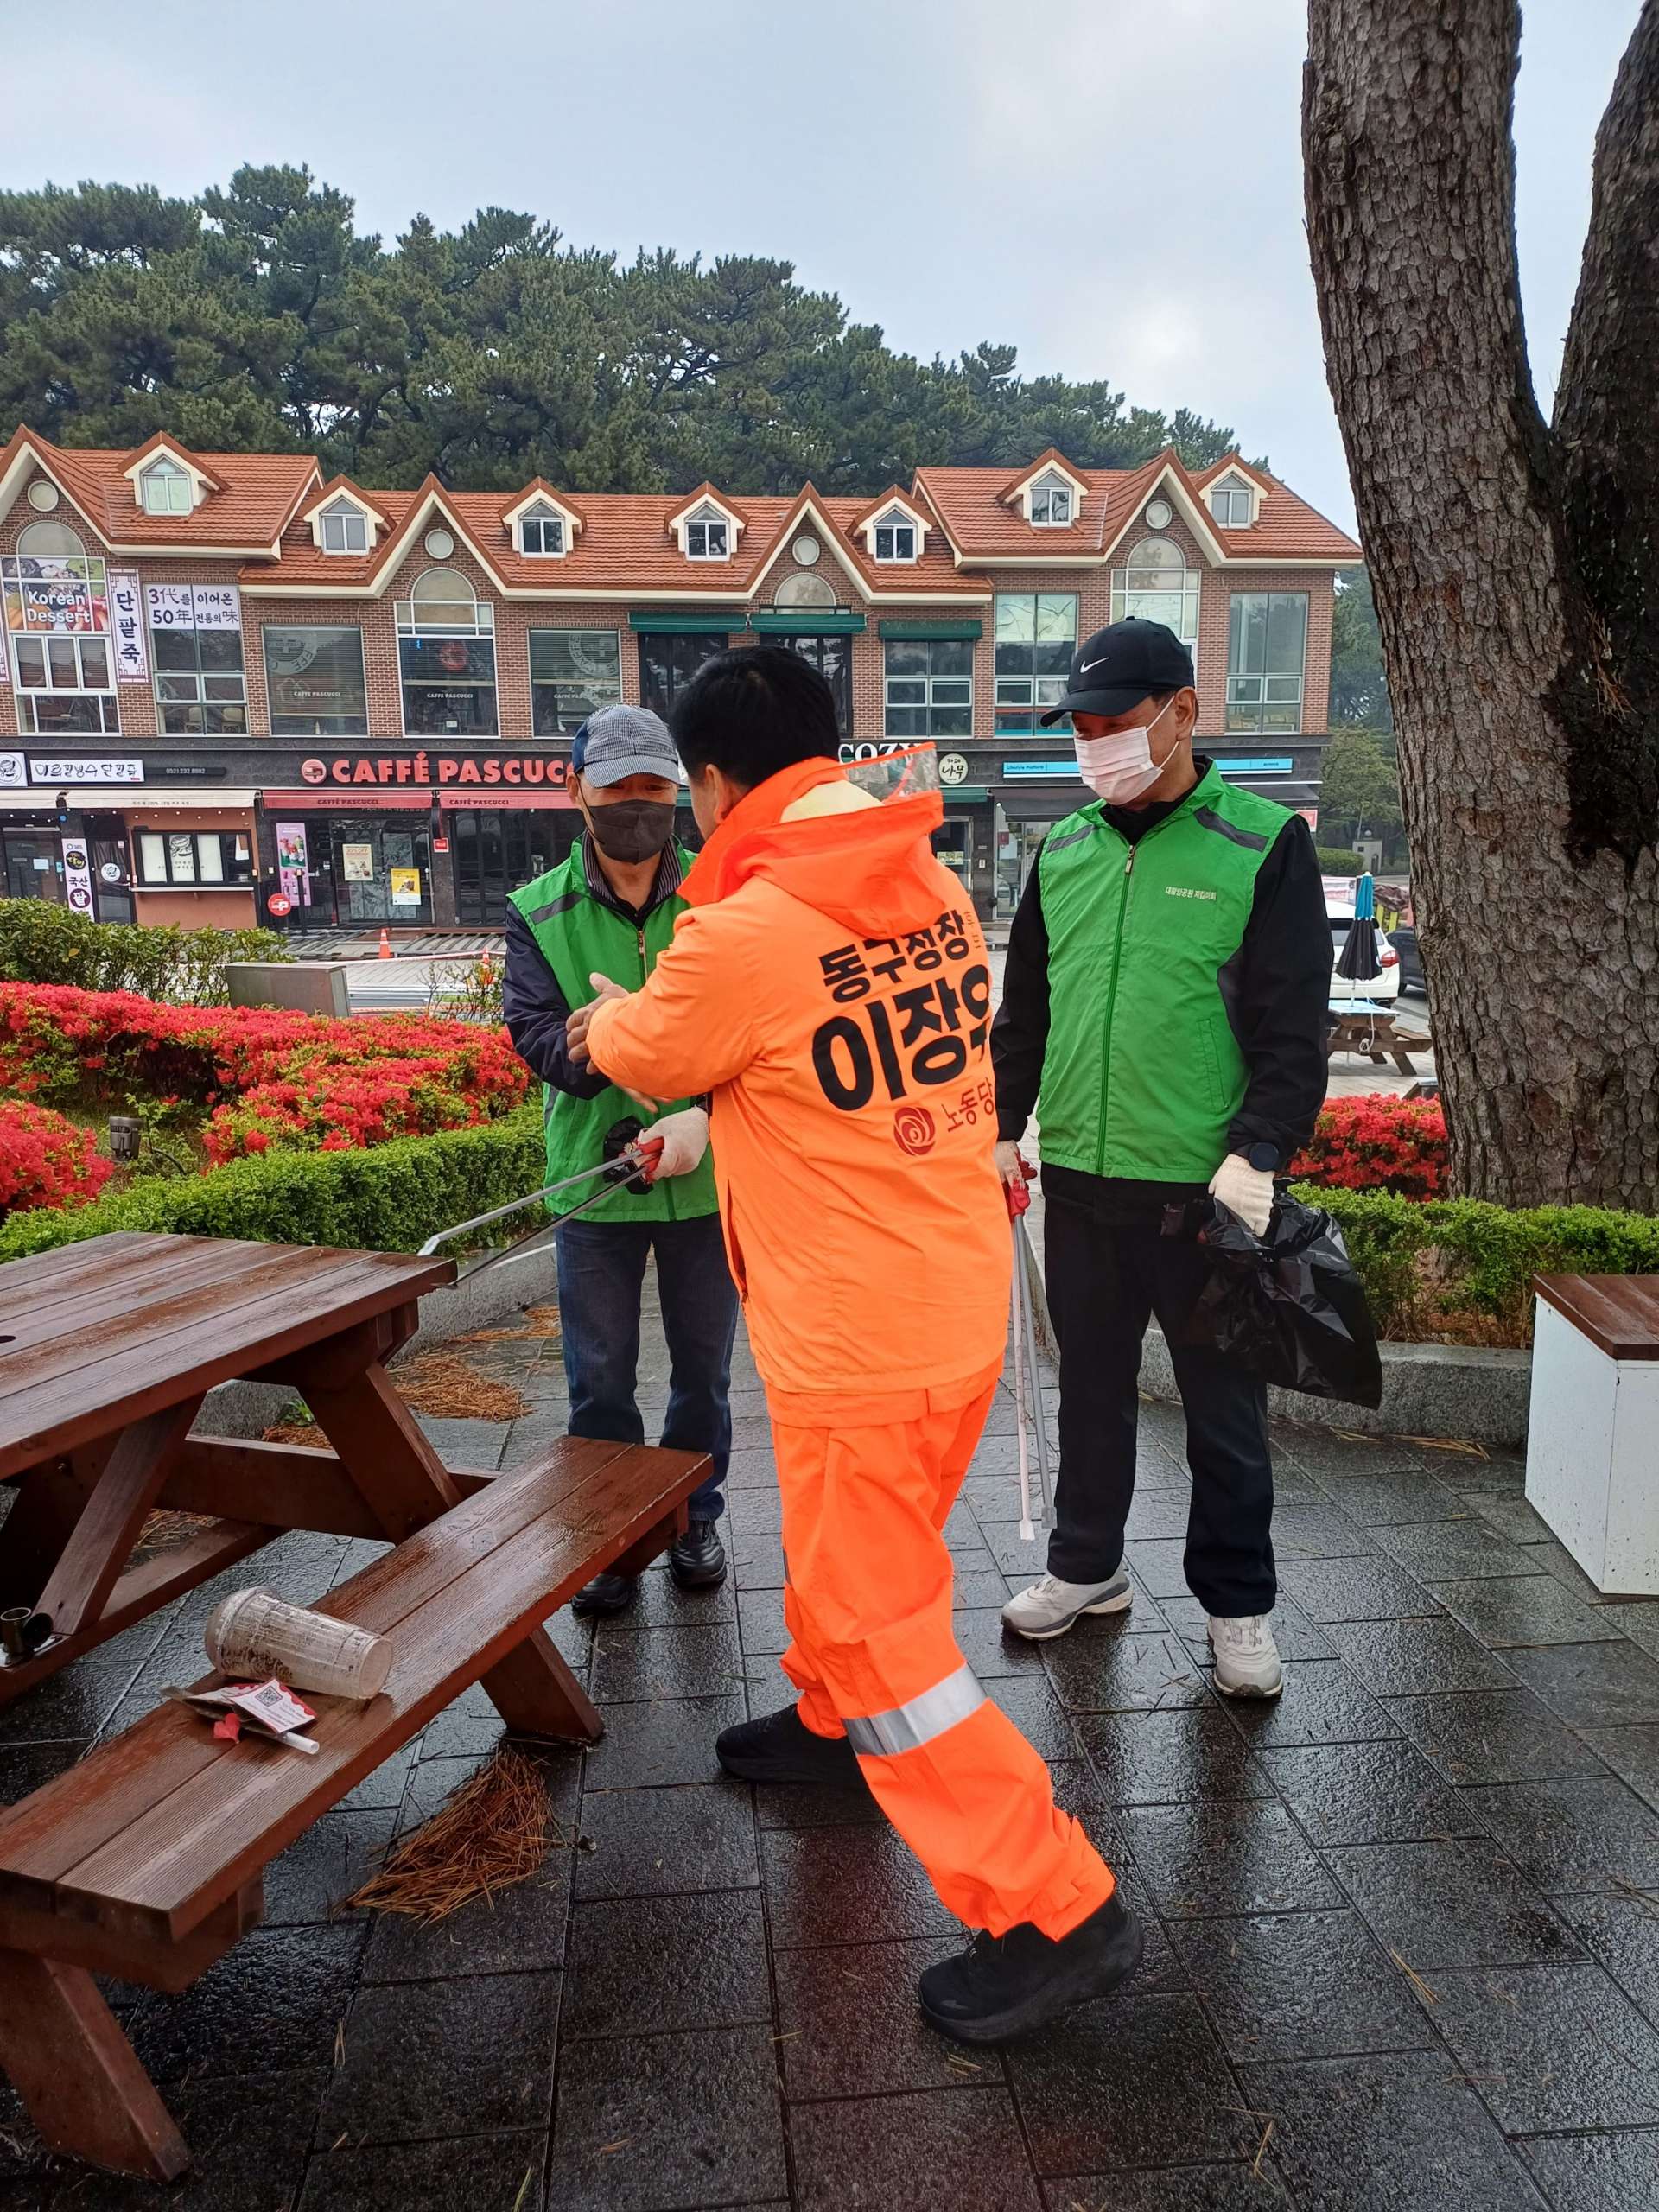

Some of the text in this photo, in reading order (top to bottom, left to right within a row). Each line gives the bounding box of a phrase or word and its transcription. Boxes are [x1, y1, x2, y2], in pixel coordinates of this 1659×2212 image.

[28, 590, 86, 606] Korean
[197, 591, 233, 607] 이어온
[27, 608, 90, 623] Dessert
[116, 590, 141, 664] 단팥죽
[837, 742, 922, 764] COZ
[331, 751, 574, 784] CAFFÉ PASCUC
[941, 765, 964, 780] 나무
[68, 876, 88, 887] 국산
[941, 1077, 995, 1132] 노동당
